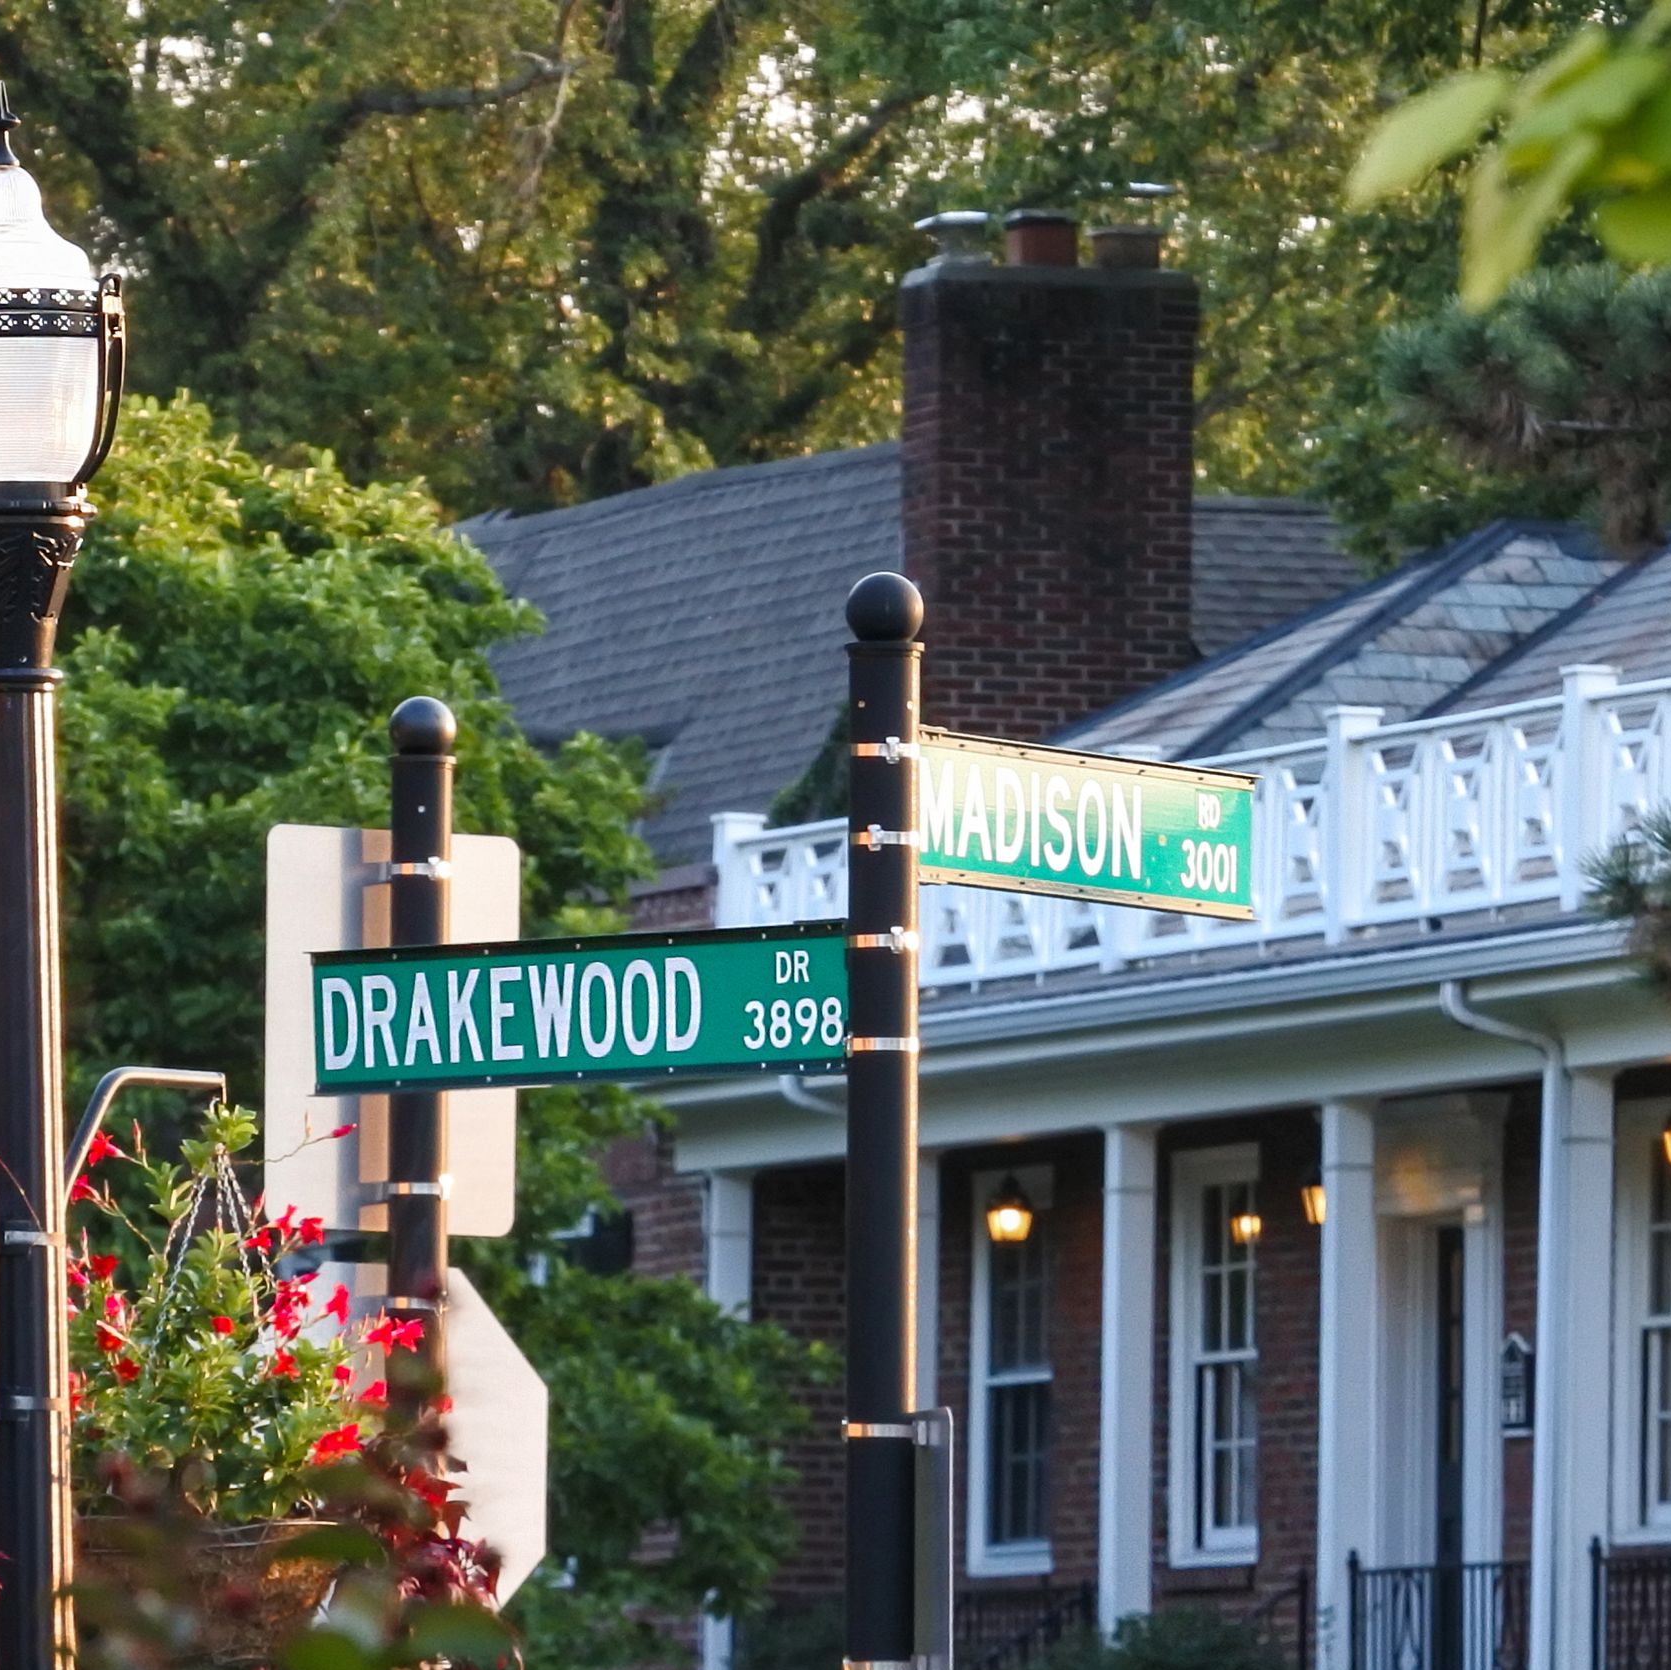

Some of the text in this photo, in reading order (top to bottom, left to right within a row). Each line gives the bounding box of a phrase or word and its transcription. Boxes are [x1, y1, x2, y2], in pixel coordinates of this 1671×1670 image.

[919, 756, 1221, 880] MADISON RD
[1180, 838, 1237, 893] 3001
[321, 949, 810, 1071] DRAKEWOOD DR
[743, 996, 843, 1051] 3898
